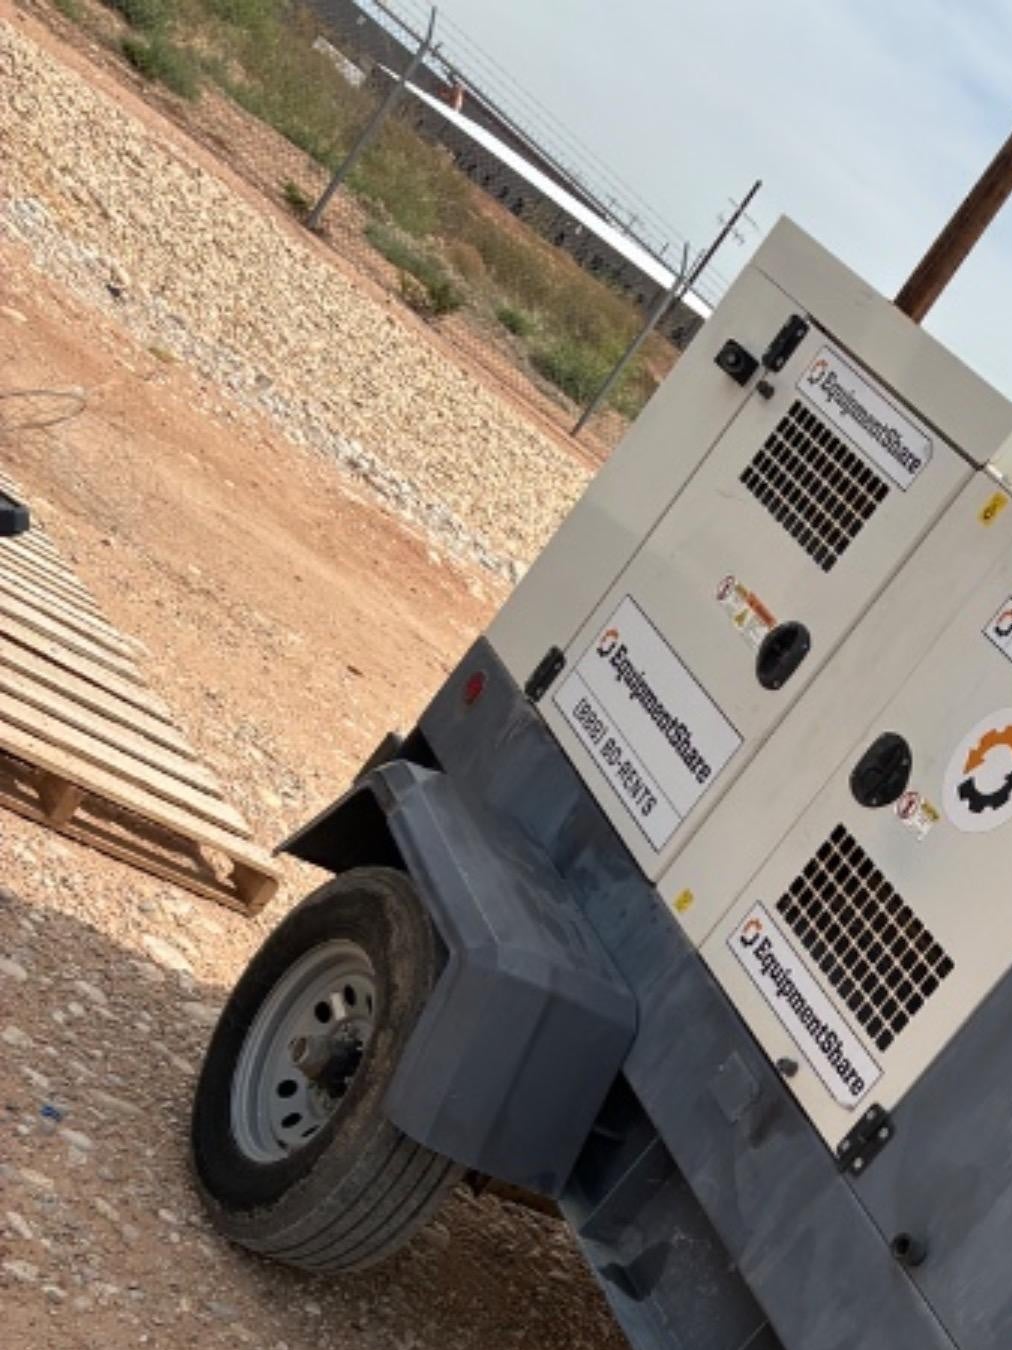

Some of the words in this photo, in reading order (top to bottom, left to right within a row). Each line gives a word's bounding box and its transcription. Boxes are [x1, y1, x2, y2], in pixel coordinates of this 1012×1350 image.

[821, 371, 921, 474] EquipmentShare
[572, 697, 609, 746] (888)
[599, 737, 658, 817] 80-RENTS
[609, 644, 711, 784] EquipmentShare
[753, 936, 865, 1096] EquipmentShare
